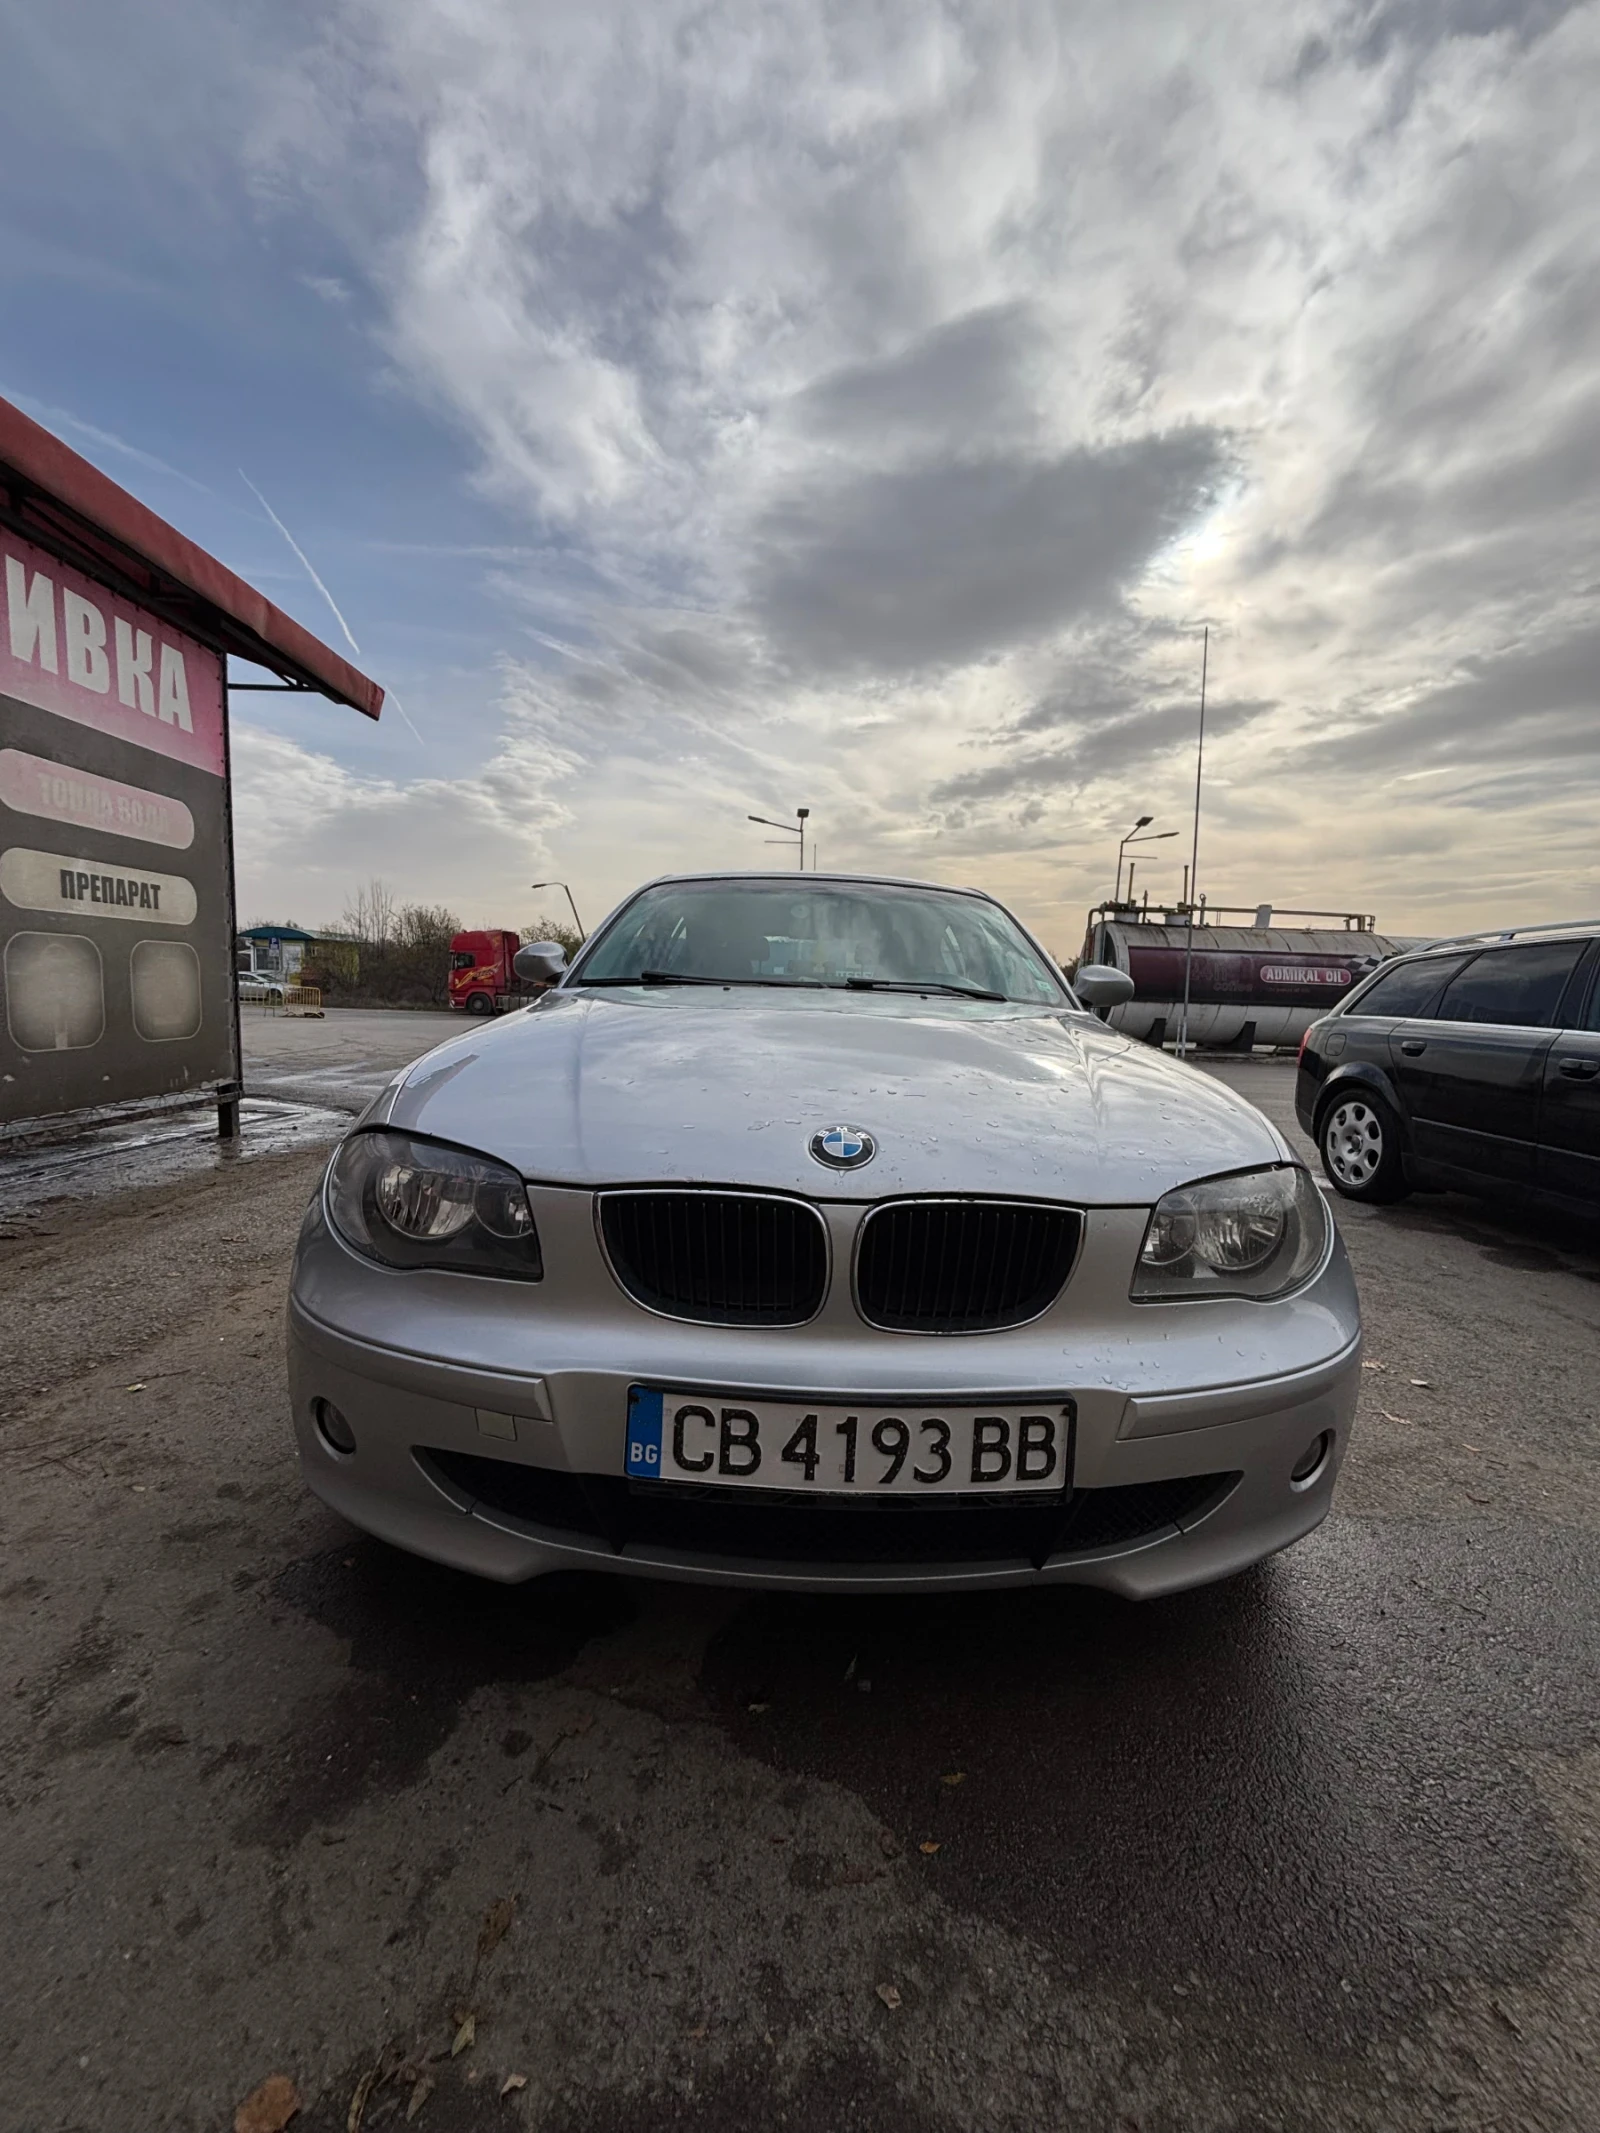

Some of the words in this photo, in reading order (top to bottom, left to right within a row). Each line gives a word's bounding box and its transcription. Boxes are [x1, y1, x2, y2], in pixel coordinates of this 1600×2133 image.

[5, 554, 194, 734] ИВКА
[60, 868, 161, 910] ПРЕПАРАТ
[1266, 967, 1321, 984] ADMIRAL
[1325, 971, 1344, 983] OIL
[630, 1441, 658, 1464] BG
[673, 1404, 762, 1476] CB
[781, 1414, 952, 1484] 4193
[970, 1415, 1057, 1483] BB
